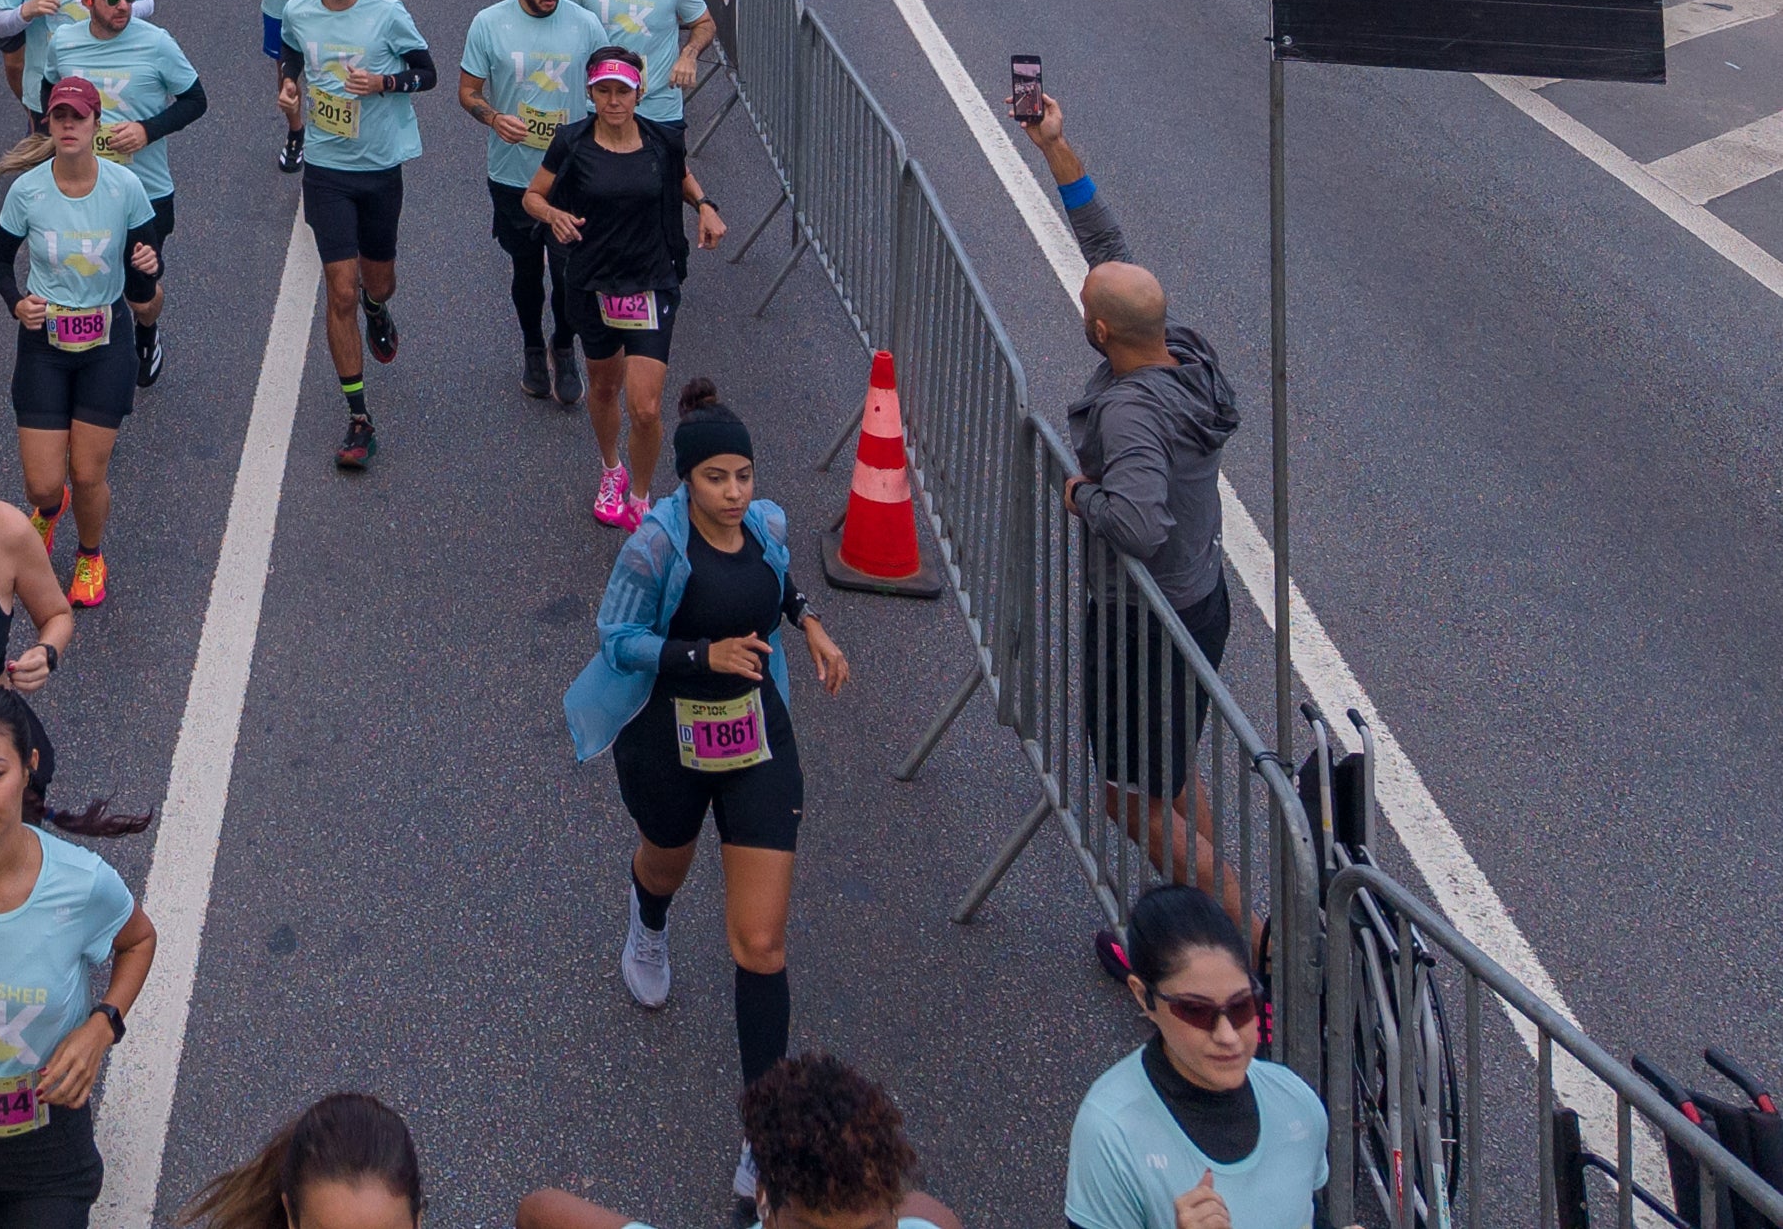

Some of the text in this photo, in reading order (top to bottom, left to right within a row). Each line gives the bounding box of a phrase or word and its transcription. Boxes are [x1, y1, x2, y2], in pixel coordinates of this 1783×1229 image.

[317, 101, 352, 124] 2013
[528, 118, 562, 137] 205
[606, 295, 647, 313] 1732
[61, 315, 104, 335] 1858
[692, 703, 727, 716] SP10K
[701, 717, 755, 748] 1861
